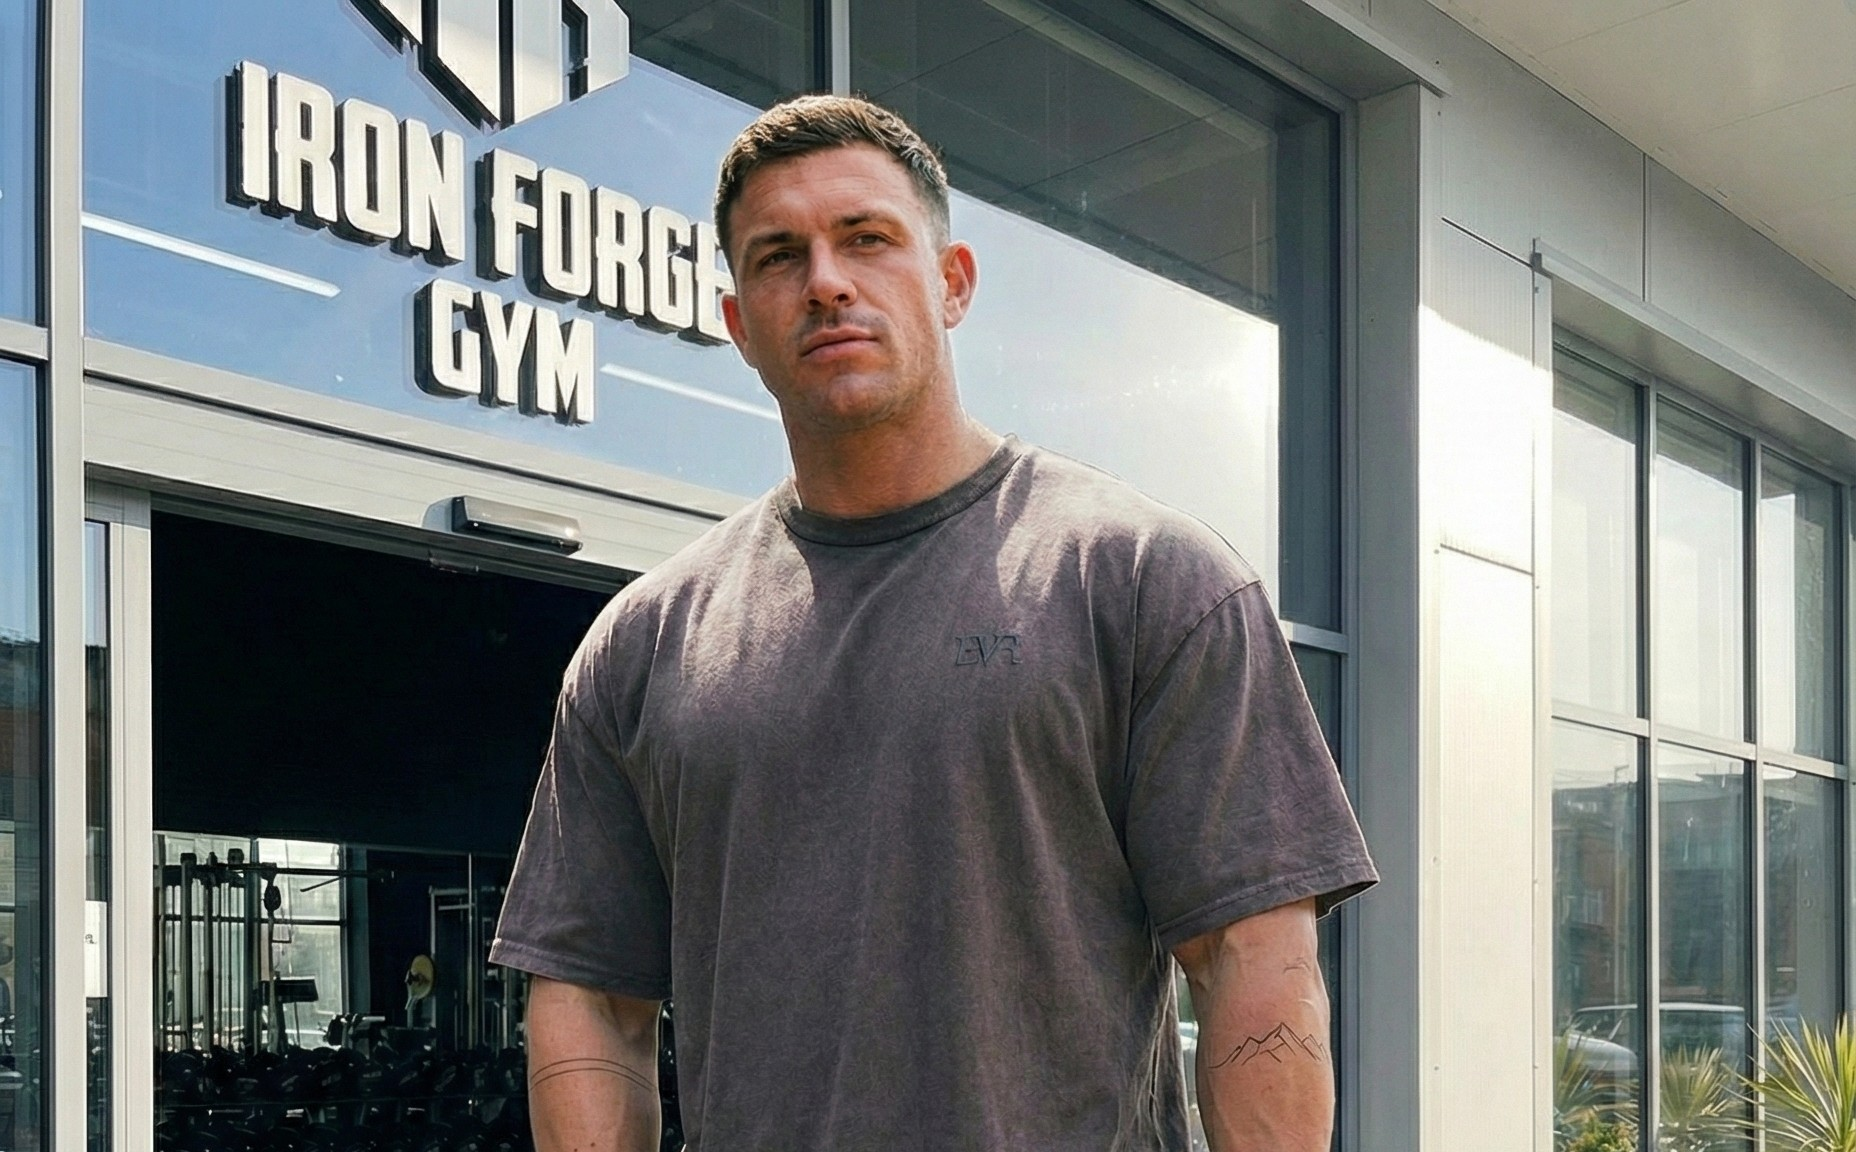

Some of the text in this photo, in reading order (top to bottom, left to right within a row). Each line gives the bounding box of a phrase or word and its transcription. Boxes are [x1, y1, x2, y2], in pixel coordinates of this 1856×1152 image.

[228, 60, 734, 345] IRON FORGE
[416, 278, 594, 424] GYM
